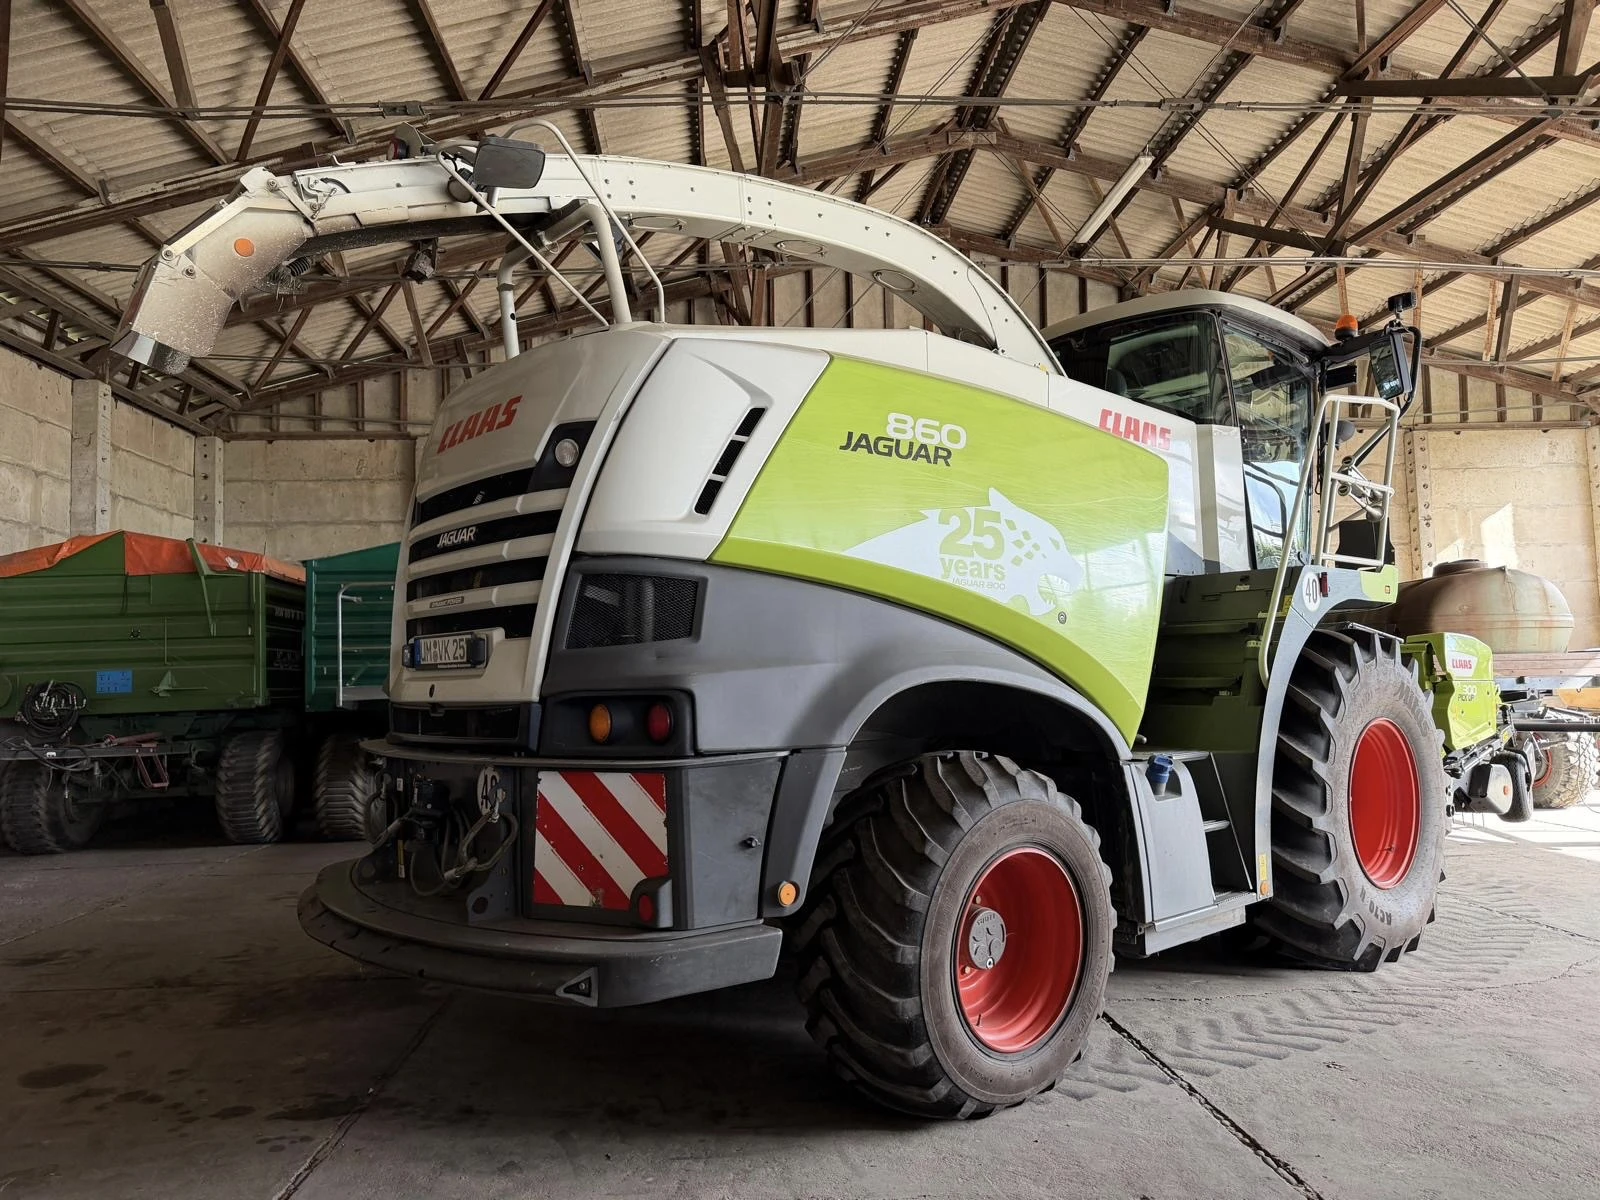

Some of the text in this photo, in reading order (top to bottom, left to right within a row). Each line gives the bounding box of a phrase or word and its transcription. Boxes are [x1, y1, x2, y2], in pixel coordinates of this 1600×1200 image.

[437, 395, 523, 455] CLAAS
[886, 412, 968, 450] 860
[1098, 408, 1172, 451] CLAAS
[839, 431, 953, 467] JAGUAR
[437, 526, 477, 548] JAGUAR
[938, 507, 1005, 561] 25
[939, 557, 1006, 581] years
[1305, 577, 1318, 604] 40
[452, 637, 466, 661] 25
